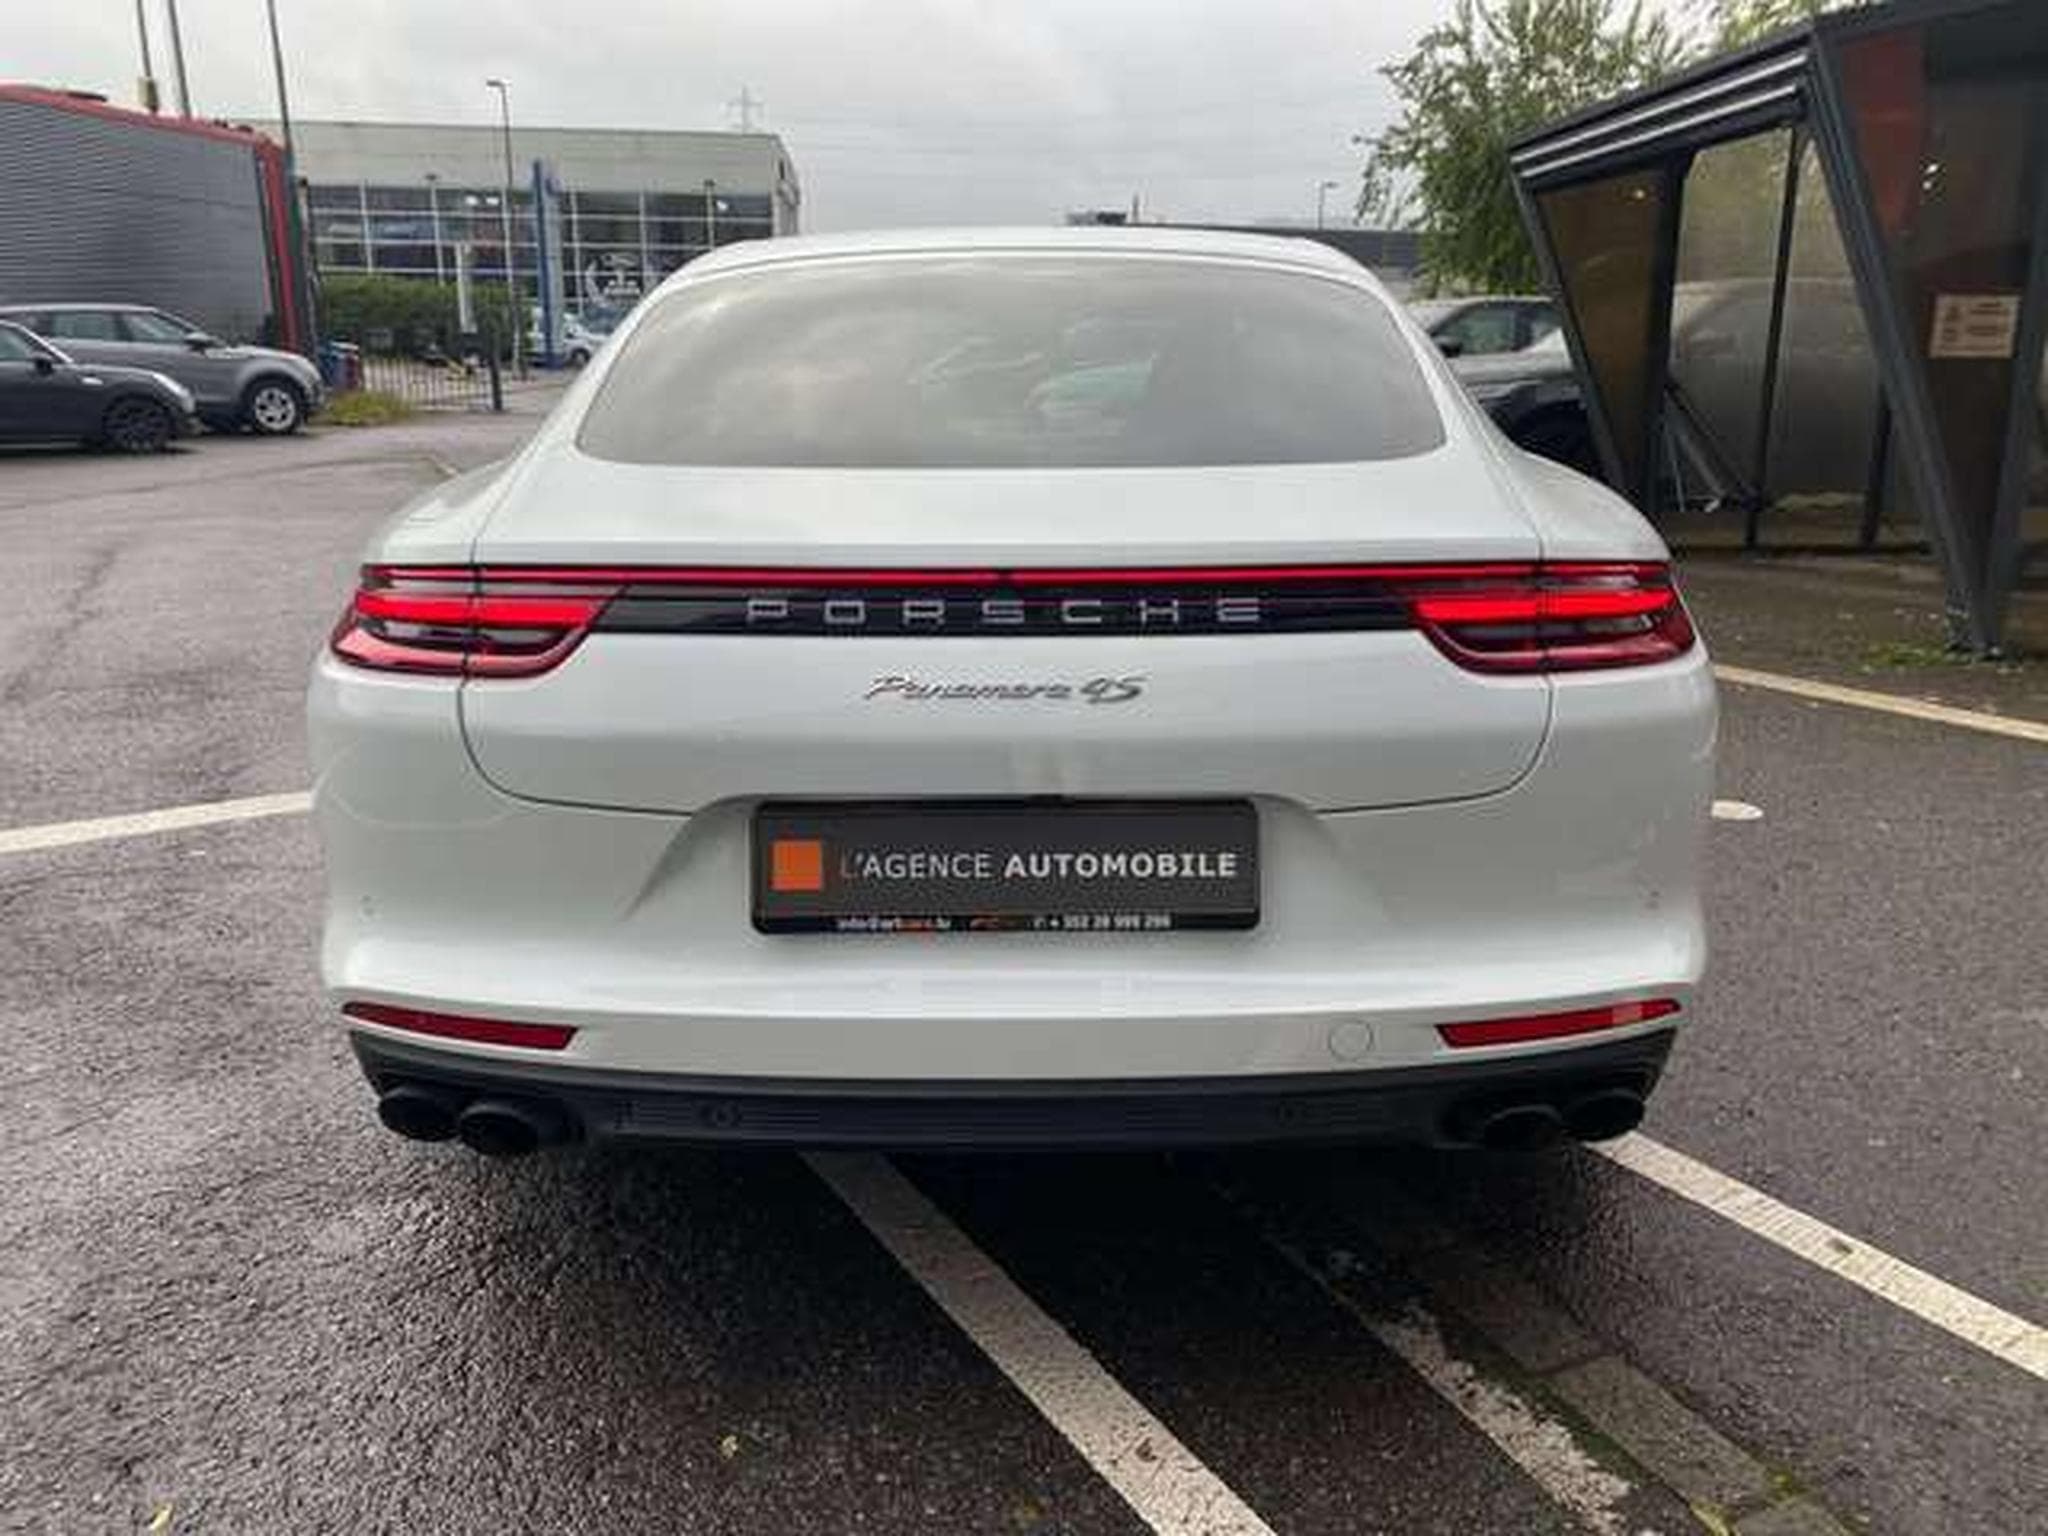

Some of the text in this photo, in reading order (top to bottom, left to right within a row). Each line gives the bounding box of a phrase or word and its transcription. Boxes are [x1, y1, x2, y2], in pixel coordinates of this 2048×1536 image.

[746, 597, 1262, 625] PORSCHE
[865, 672, 1151, 703] Panamera 4S
[840, 852, 1236, 879] L'AGENCE AUTOMOBILE
